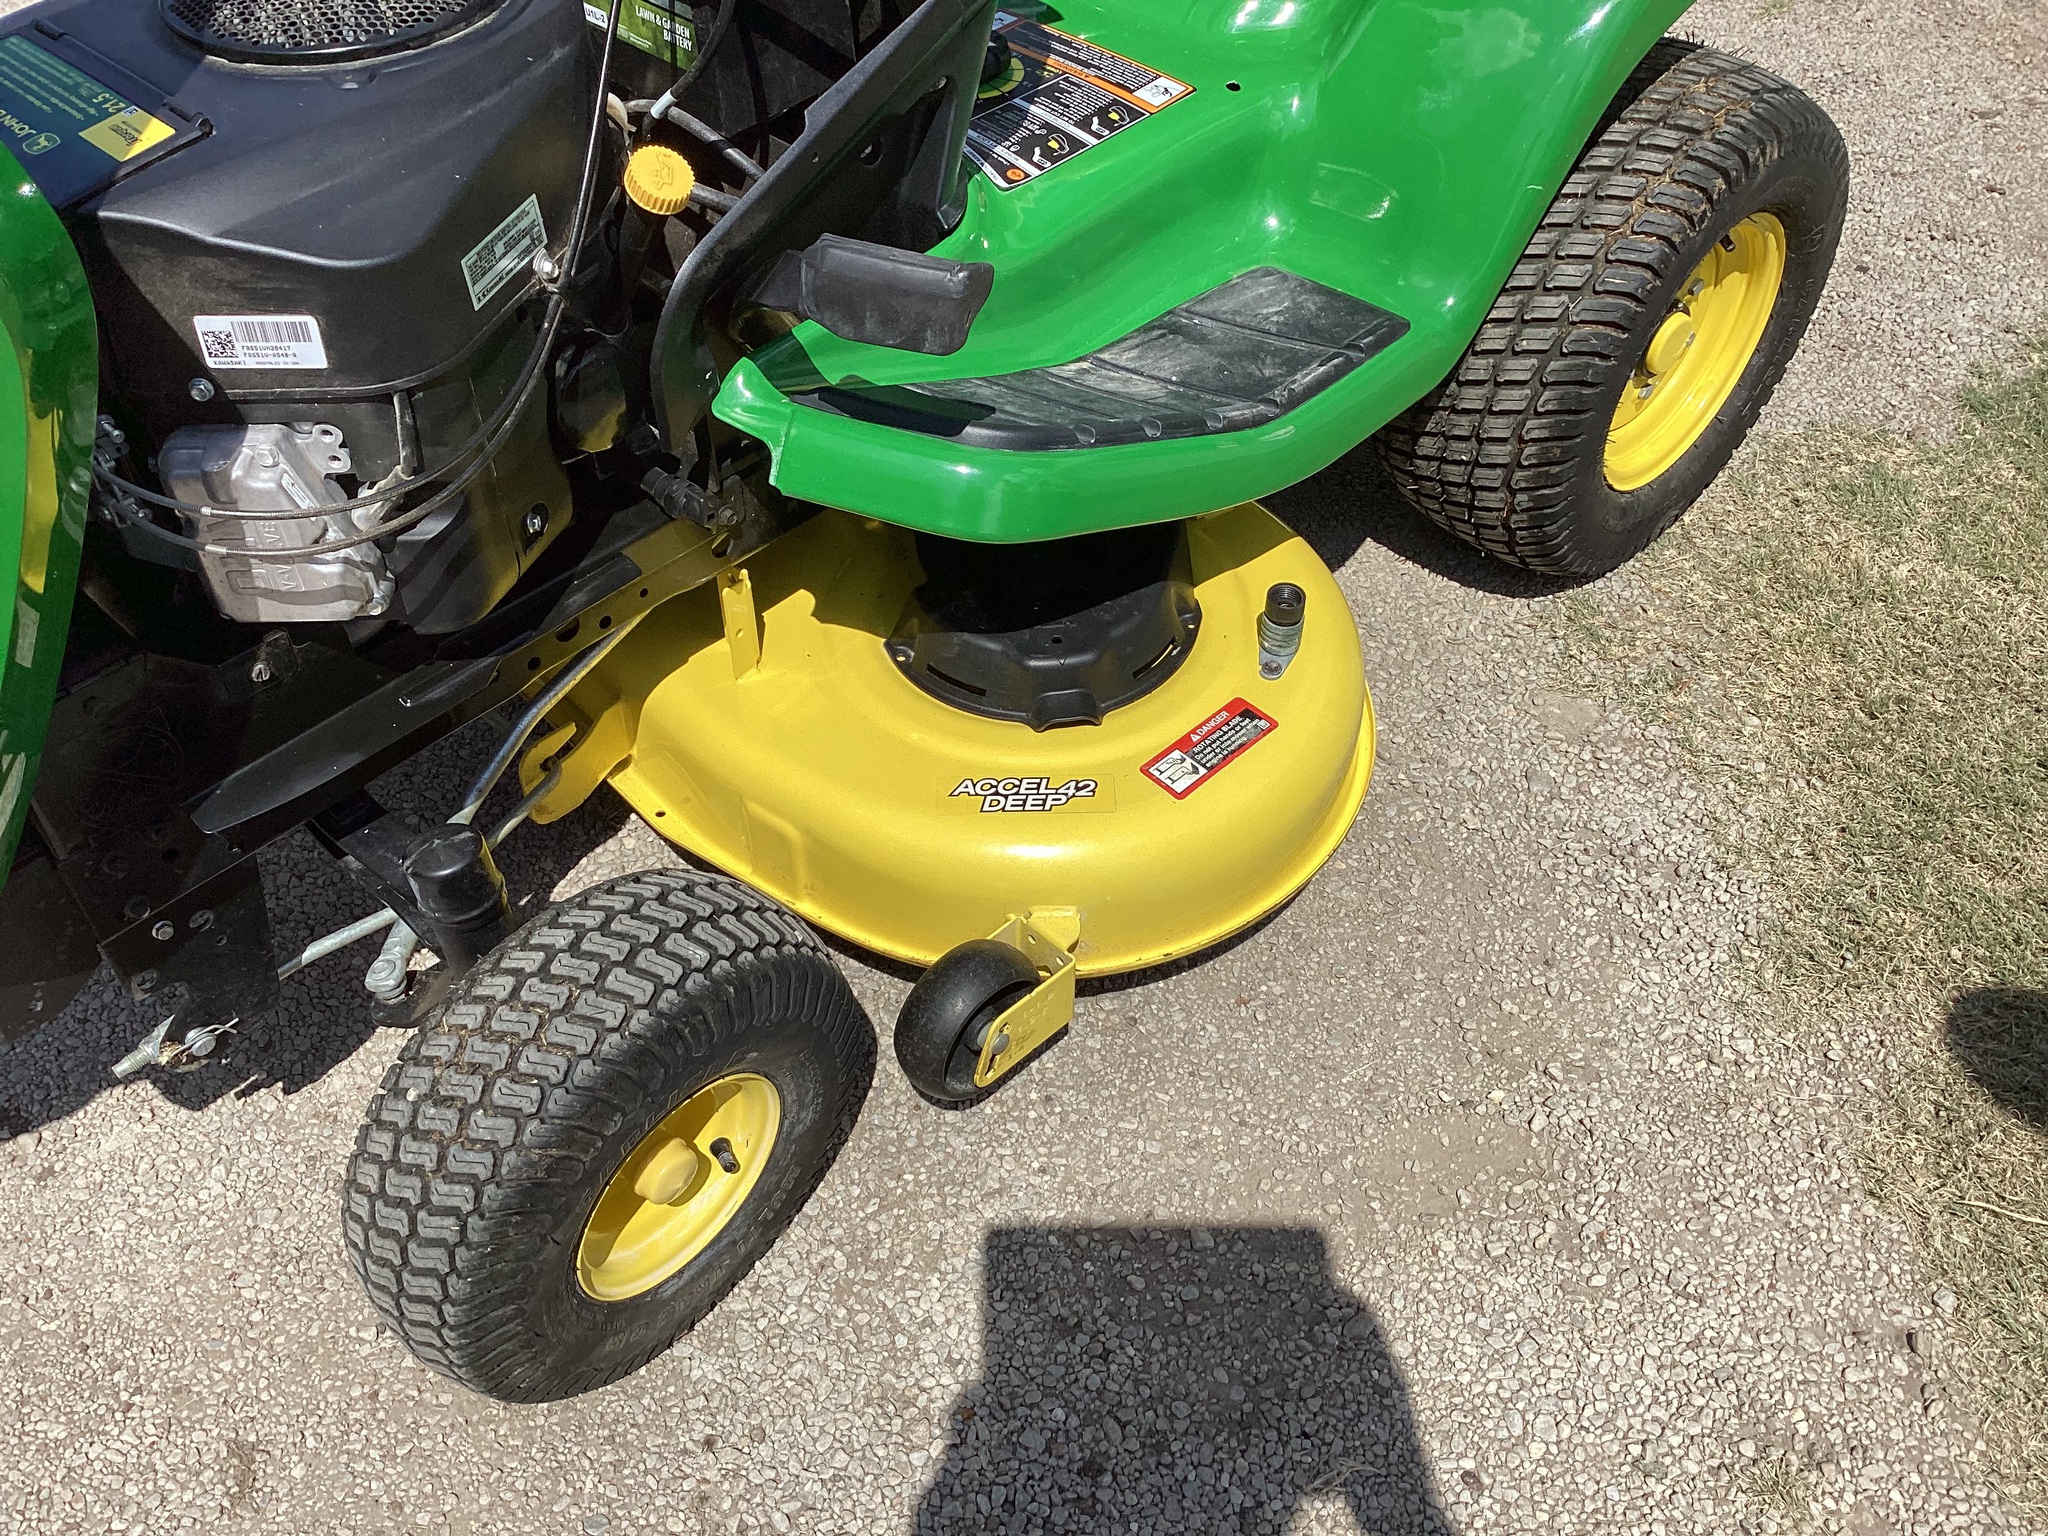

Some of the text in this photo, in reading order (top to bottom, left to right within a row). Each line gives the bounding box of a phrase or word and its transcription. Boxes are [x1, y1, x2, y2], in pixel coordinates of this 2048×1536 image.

[635, 5, 655, 24] LAWN
[656, 14, 662, 27] &
[662, 17, 690, 39] GARDEN
[663, 30, 692, 52] BATTERY
[92, 92, 126, 113] 21.5
[0, 115, 37, 137] JOHN
[1196, 710, 1230, 736] DANGER
[1192, 729, 1224, 752] ROTATING
[980, 794, 1070, 813] DEEP
